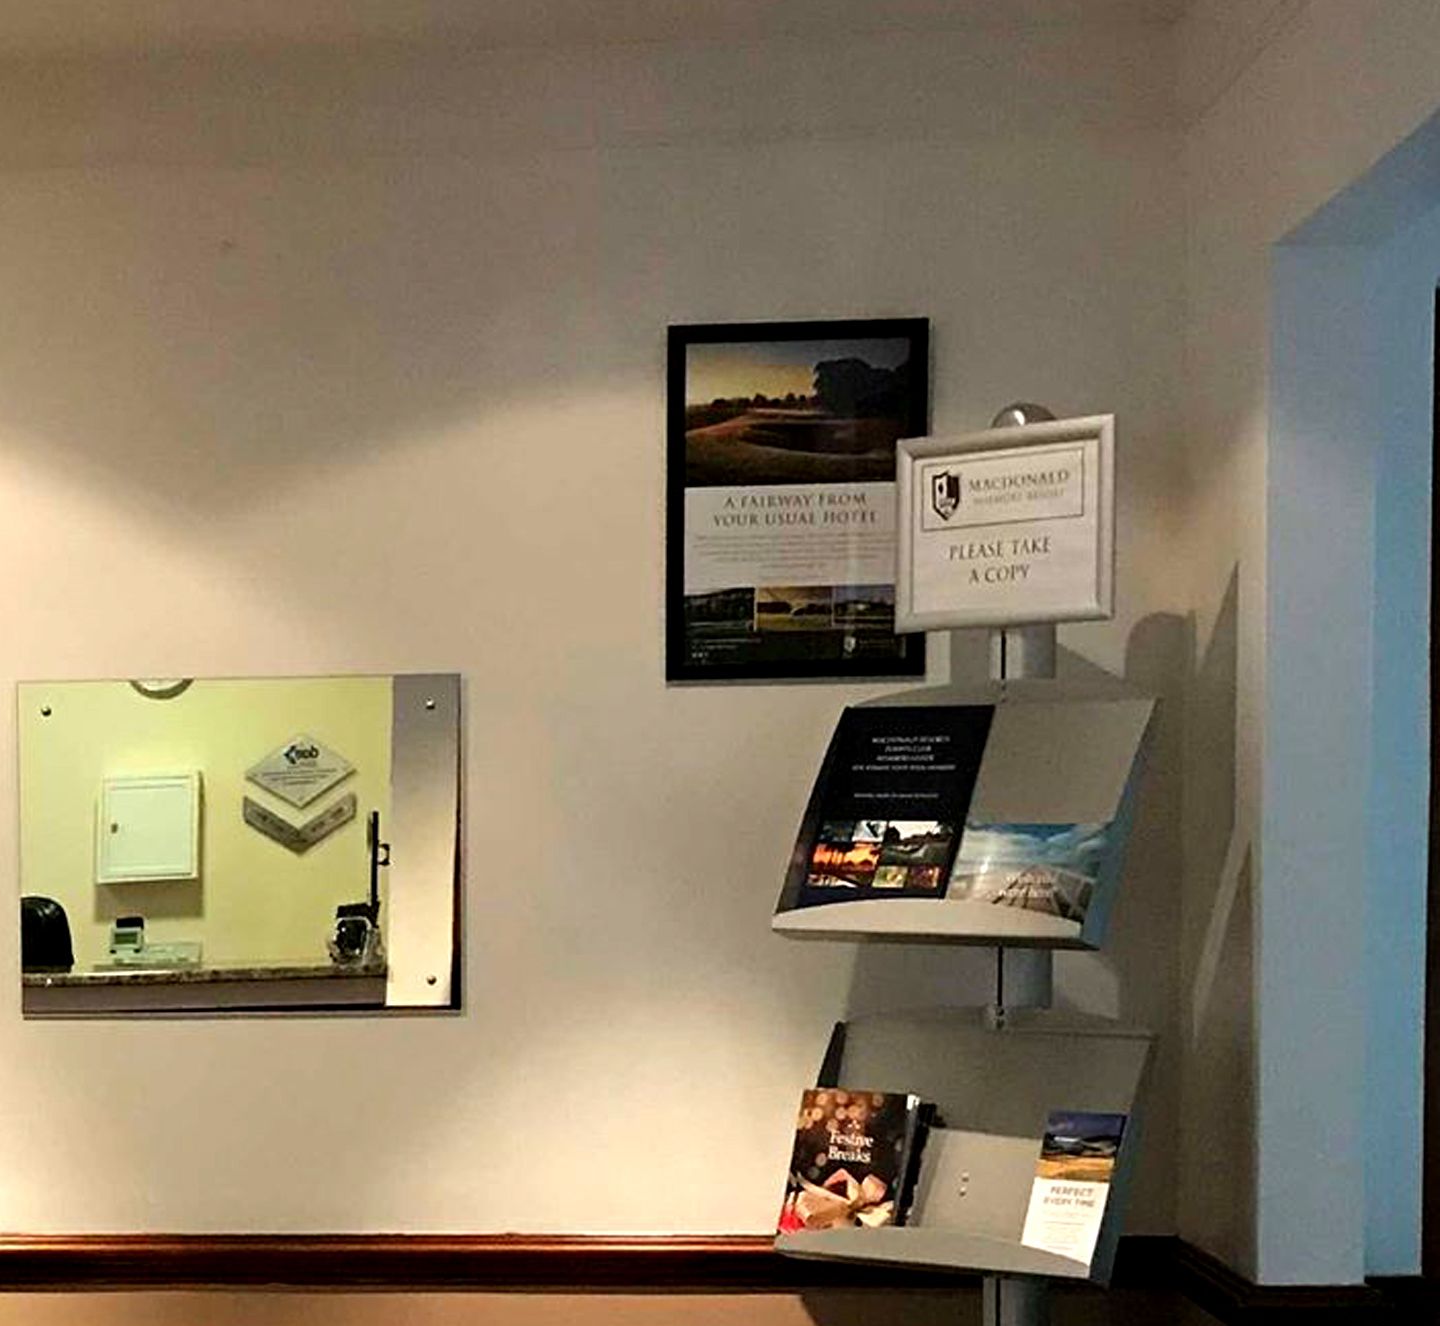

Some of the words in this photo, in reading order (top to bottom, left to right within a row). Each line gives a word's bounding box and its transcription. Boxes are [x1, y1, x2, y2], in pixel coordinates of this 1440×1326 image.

[969, 467, 1071, 491] MACDONALD
[724, 496, 734, 508] A
[740, 494, 813, 508] FAIRWAY
[819, 492, 867, 507] FROM
[714, 513, 760, 527] YOUR
[765, 511, 817, 526] USUAL
[824, 509, 877, 525] HOTEL
[949, 540, 1004, 561] PLEASE
[1011, 535, 1051, 555] TAKE
[969, 568, 980, 585] A
[984, 563, 1031, 584] COPY
[828, 1128, 874, 1148] Festive
[827, 1147, 872, 1163] Breaks
